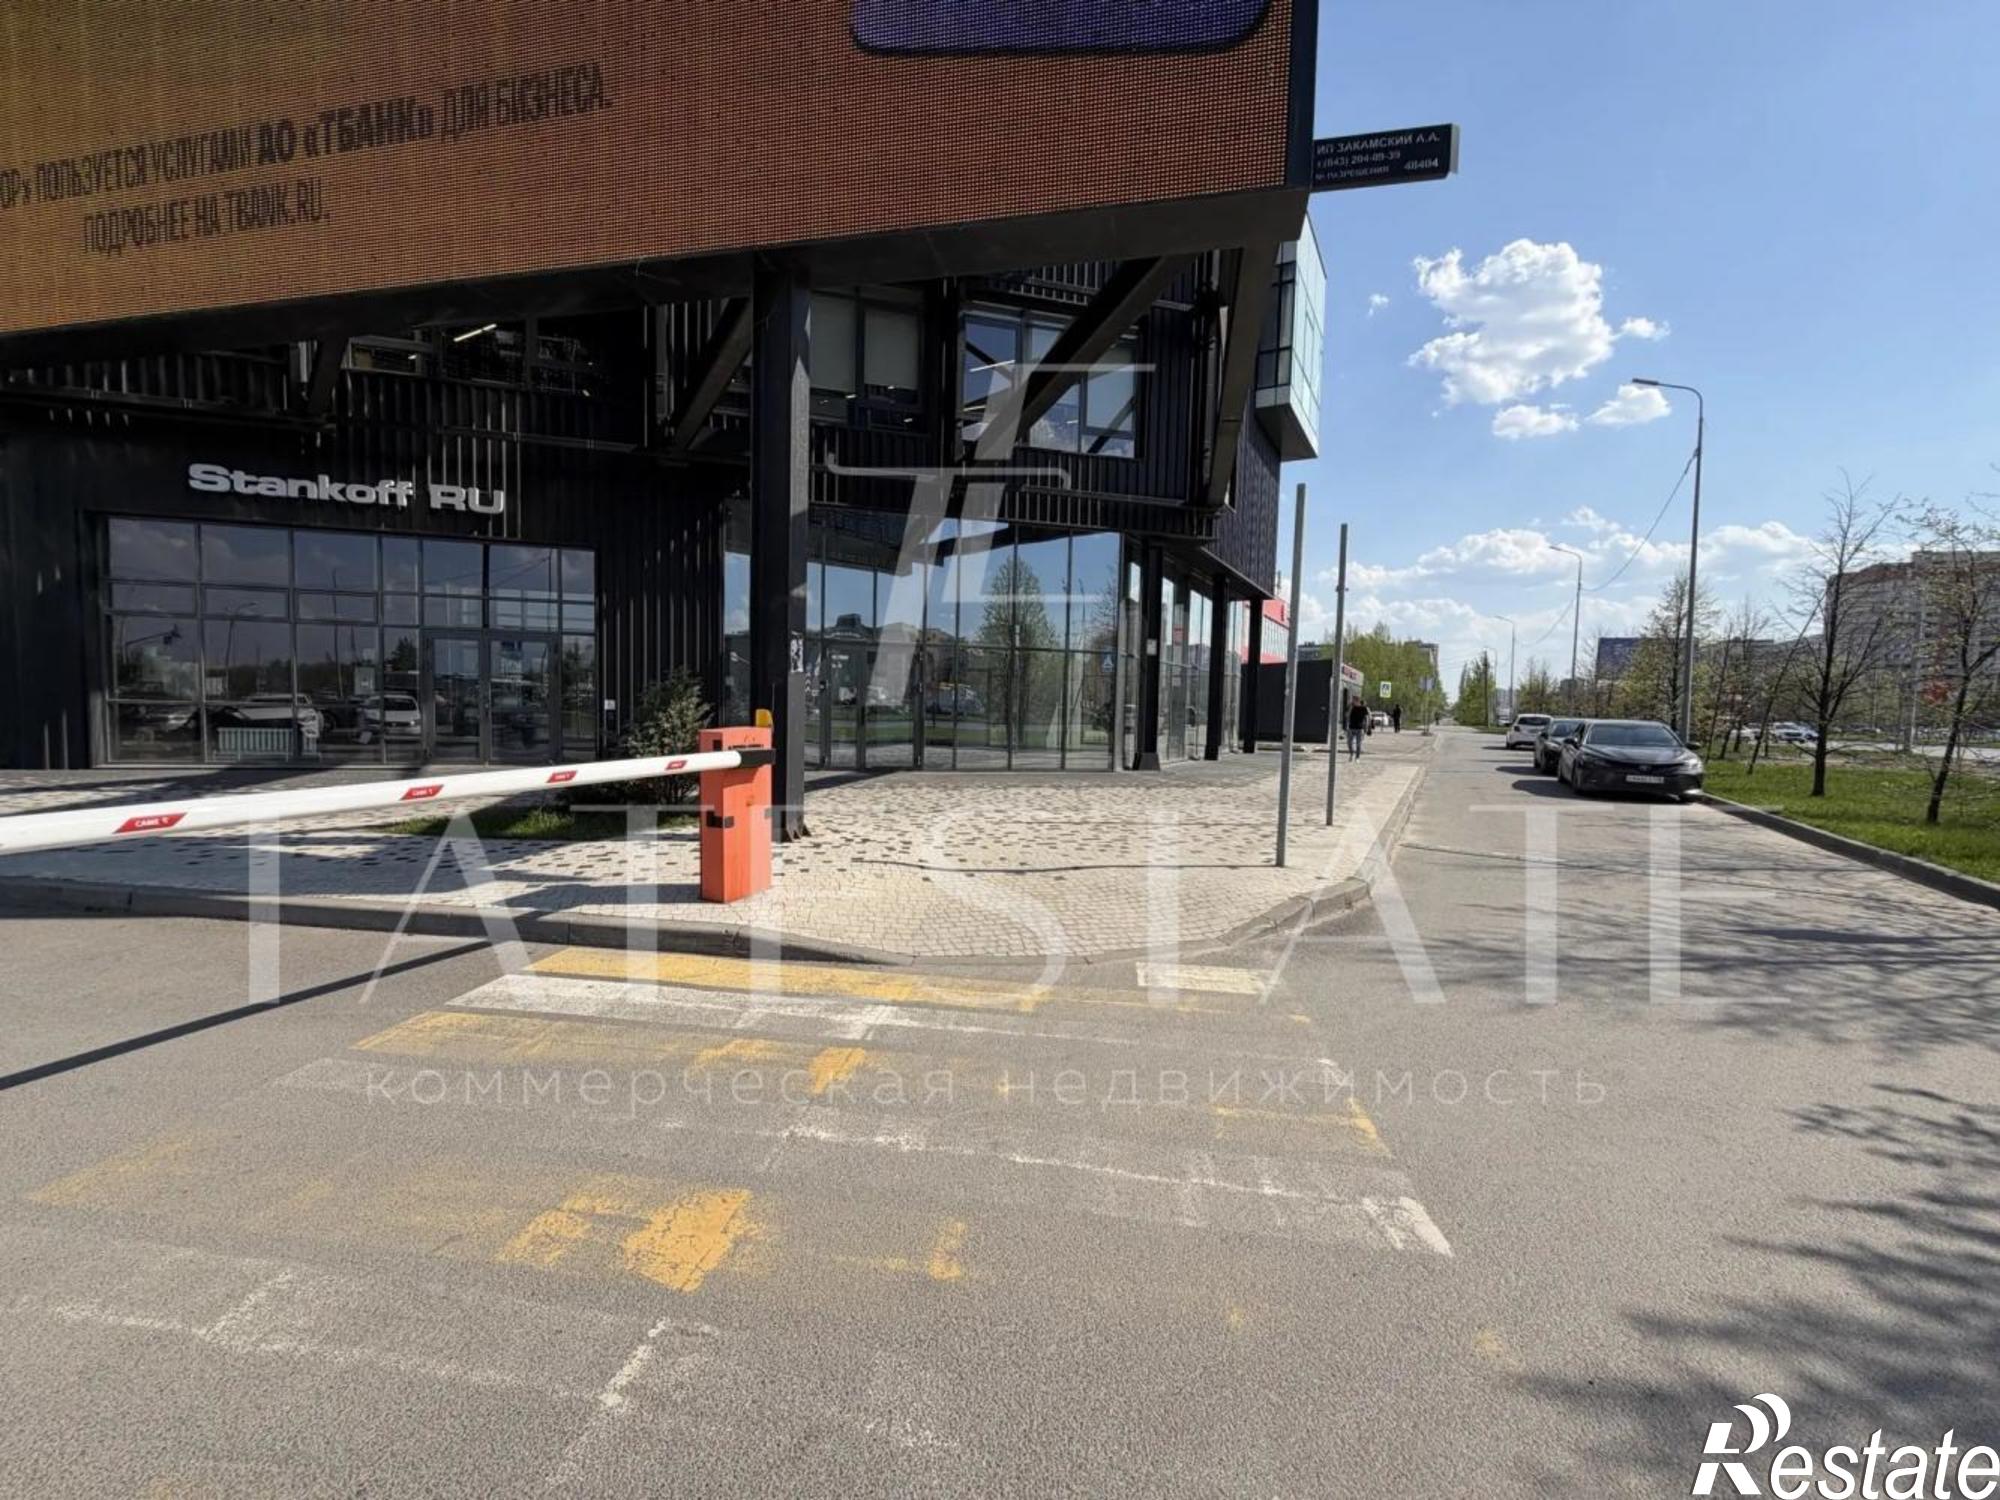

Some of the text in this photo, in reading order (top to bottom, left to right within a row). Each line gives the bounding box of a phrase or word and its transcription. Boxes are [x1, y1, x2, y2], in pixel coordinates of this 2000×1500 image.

[36, 144, 147, 202] ПОЛЬЗУЕТСЯ
[151, 126, 251, 183] УСЛУГАМИ
[257, 119, 297, 165] АО
[303, 96, 433, 158] «ТБАНК»
[441, 80, 490, 143] ДЛЯ
[496, 62, 613, 128] БИЗНЕСА.
[1316, 144, 1334, 155] ИП
[84, 199, 190, 257] ПОДРОБНЕЕ
[195, 194, 220, 237] НА
[188, 462, 505, 514] Stankoff RU
